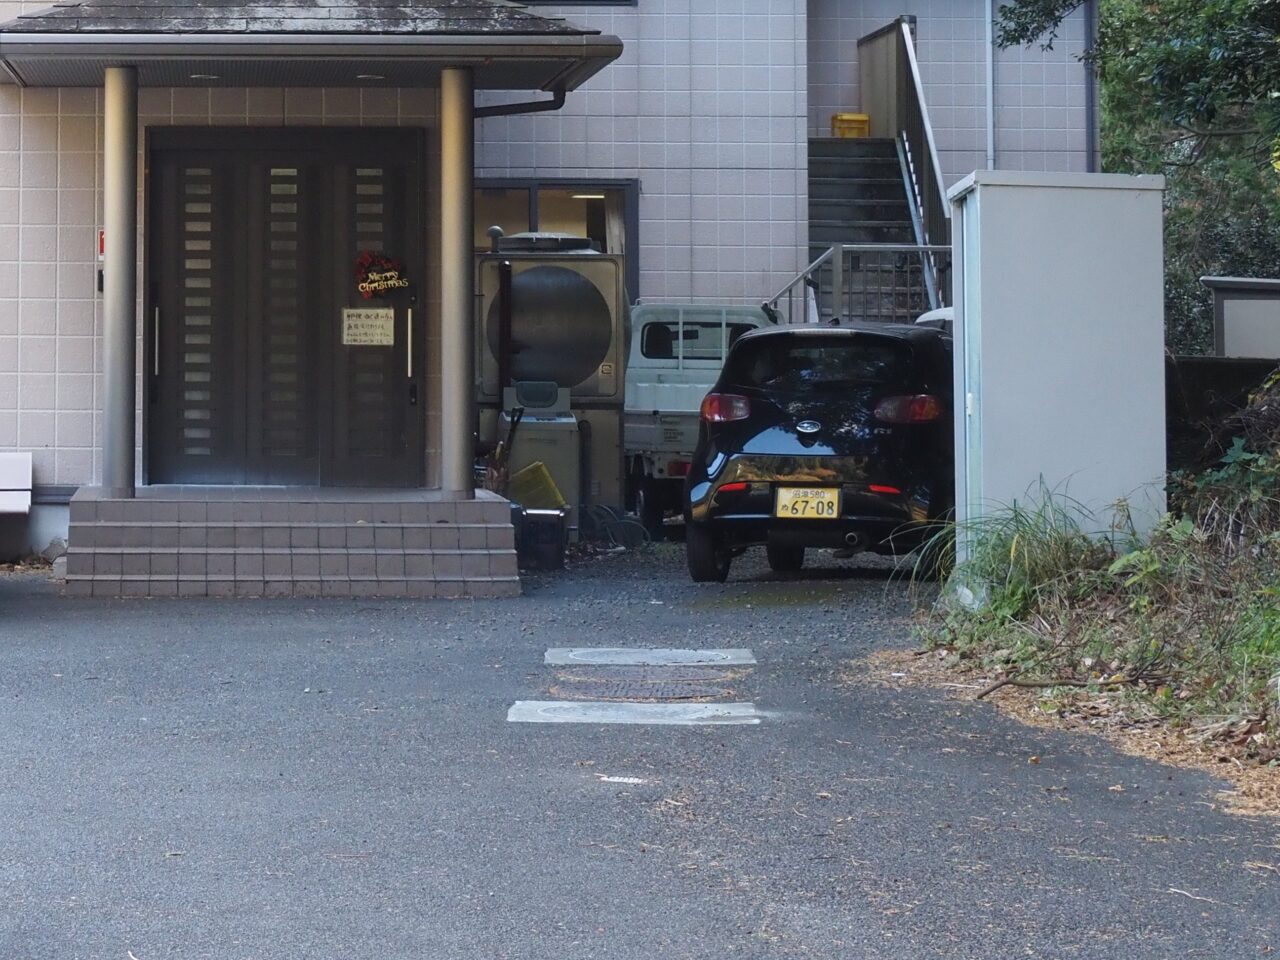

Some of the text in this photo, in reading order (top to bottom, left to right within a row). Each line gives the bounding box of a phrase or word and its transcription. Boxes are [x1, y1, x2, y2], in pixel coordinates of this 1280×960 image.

[368, 271, 399, 281] Merry
[358, 278, 409, 292] Christmas
[791, 500, 834, 515] 67-08
